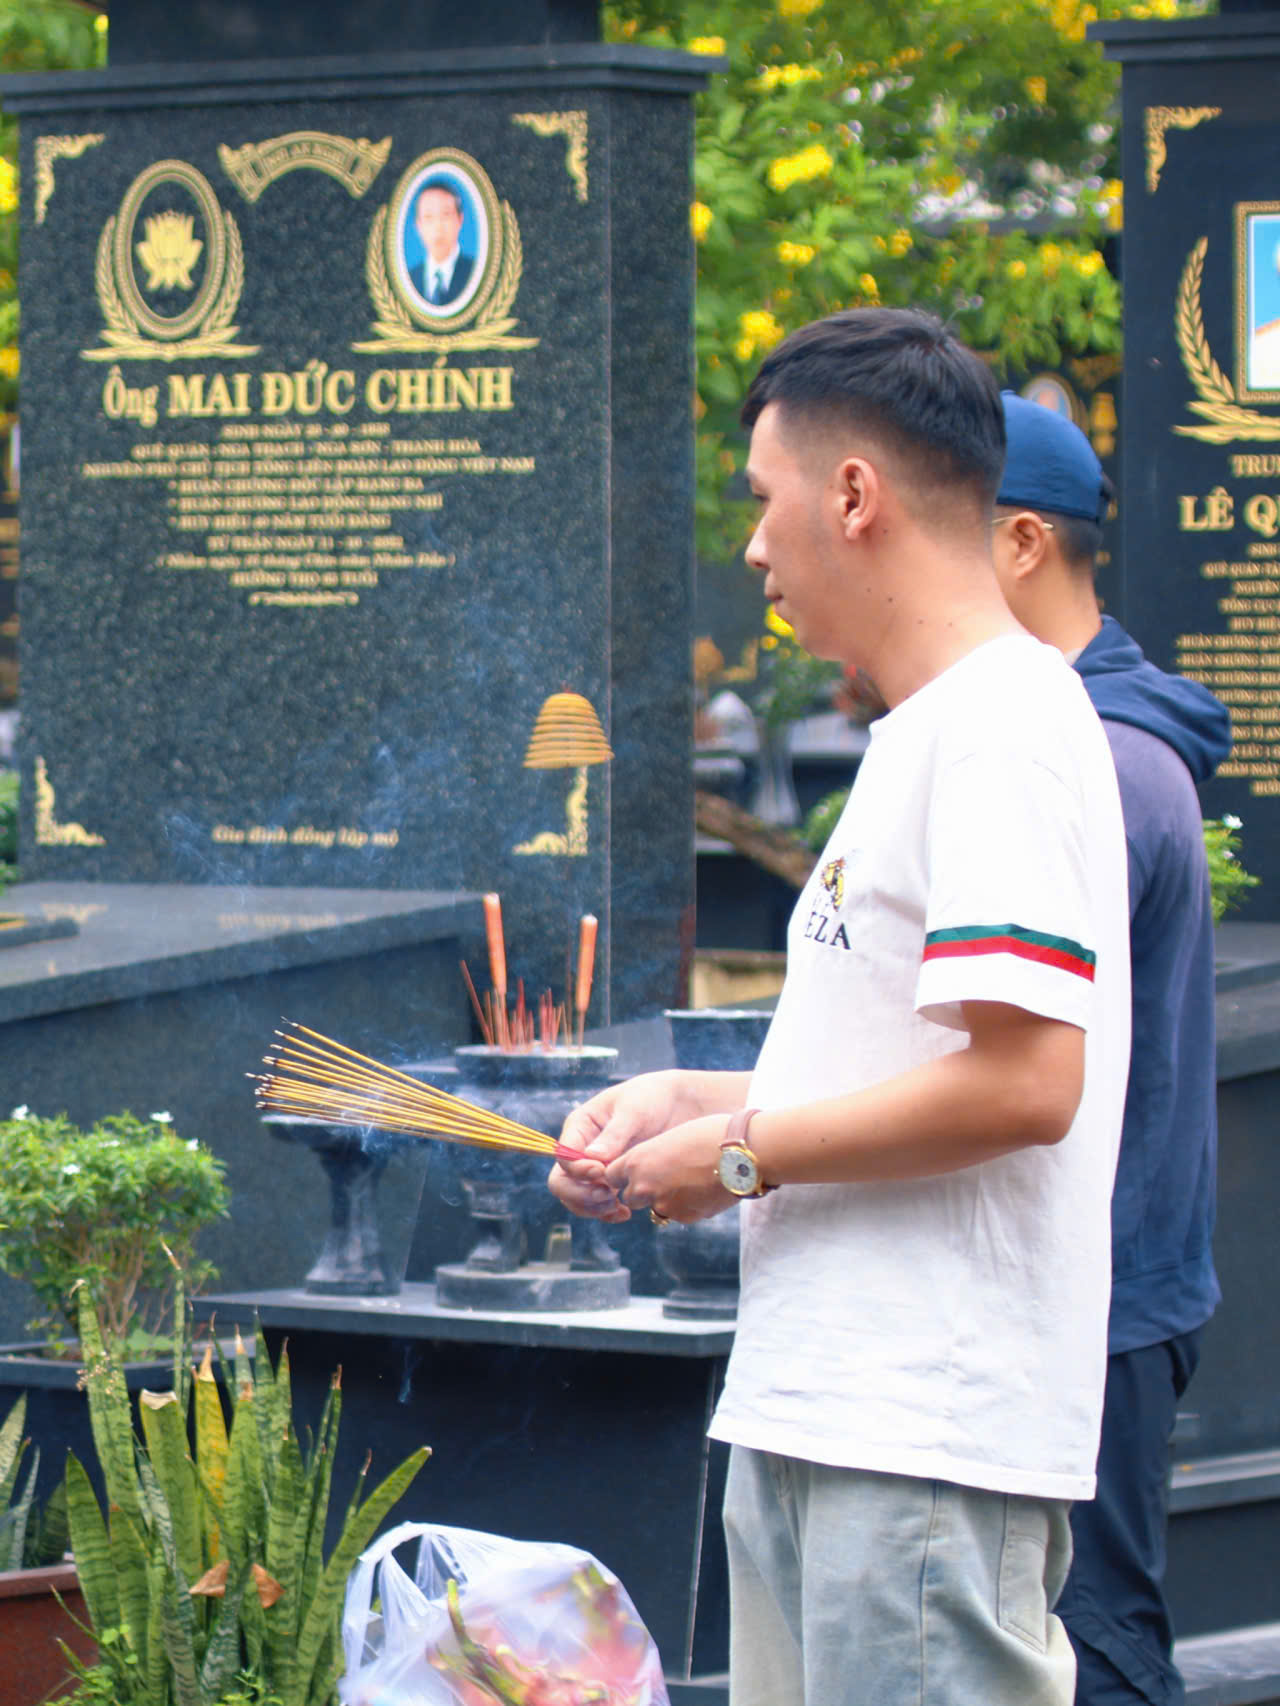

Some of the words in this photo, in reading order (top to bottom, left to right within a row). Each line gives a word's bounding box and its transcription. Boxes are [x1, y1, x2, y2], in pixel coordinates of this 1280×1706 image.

[104, 365, 159, 428] Ông
[167, 373, 252, 417] MAI
[261, 358, 356, 416] ĐỨC
[366, 355, 514, 413] CHÍNH
[1178, 486, 1235, 531] LÊ
